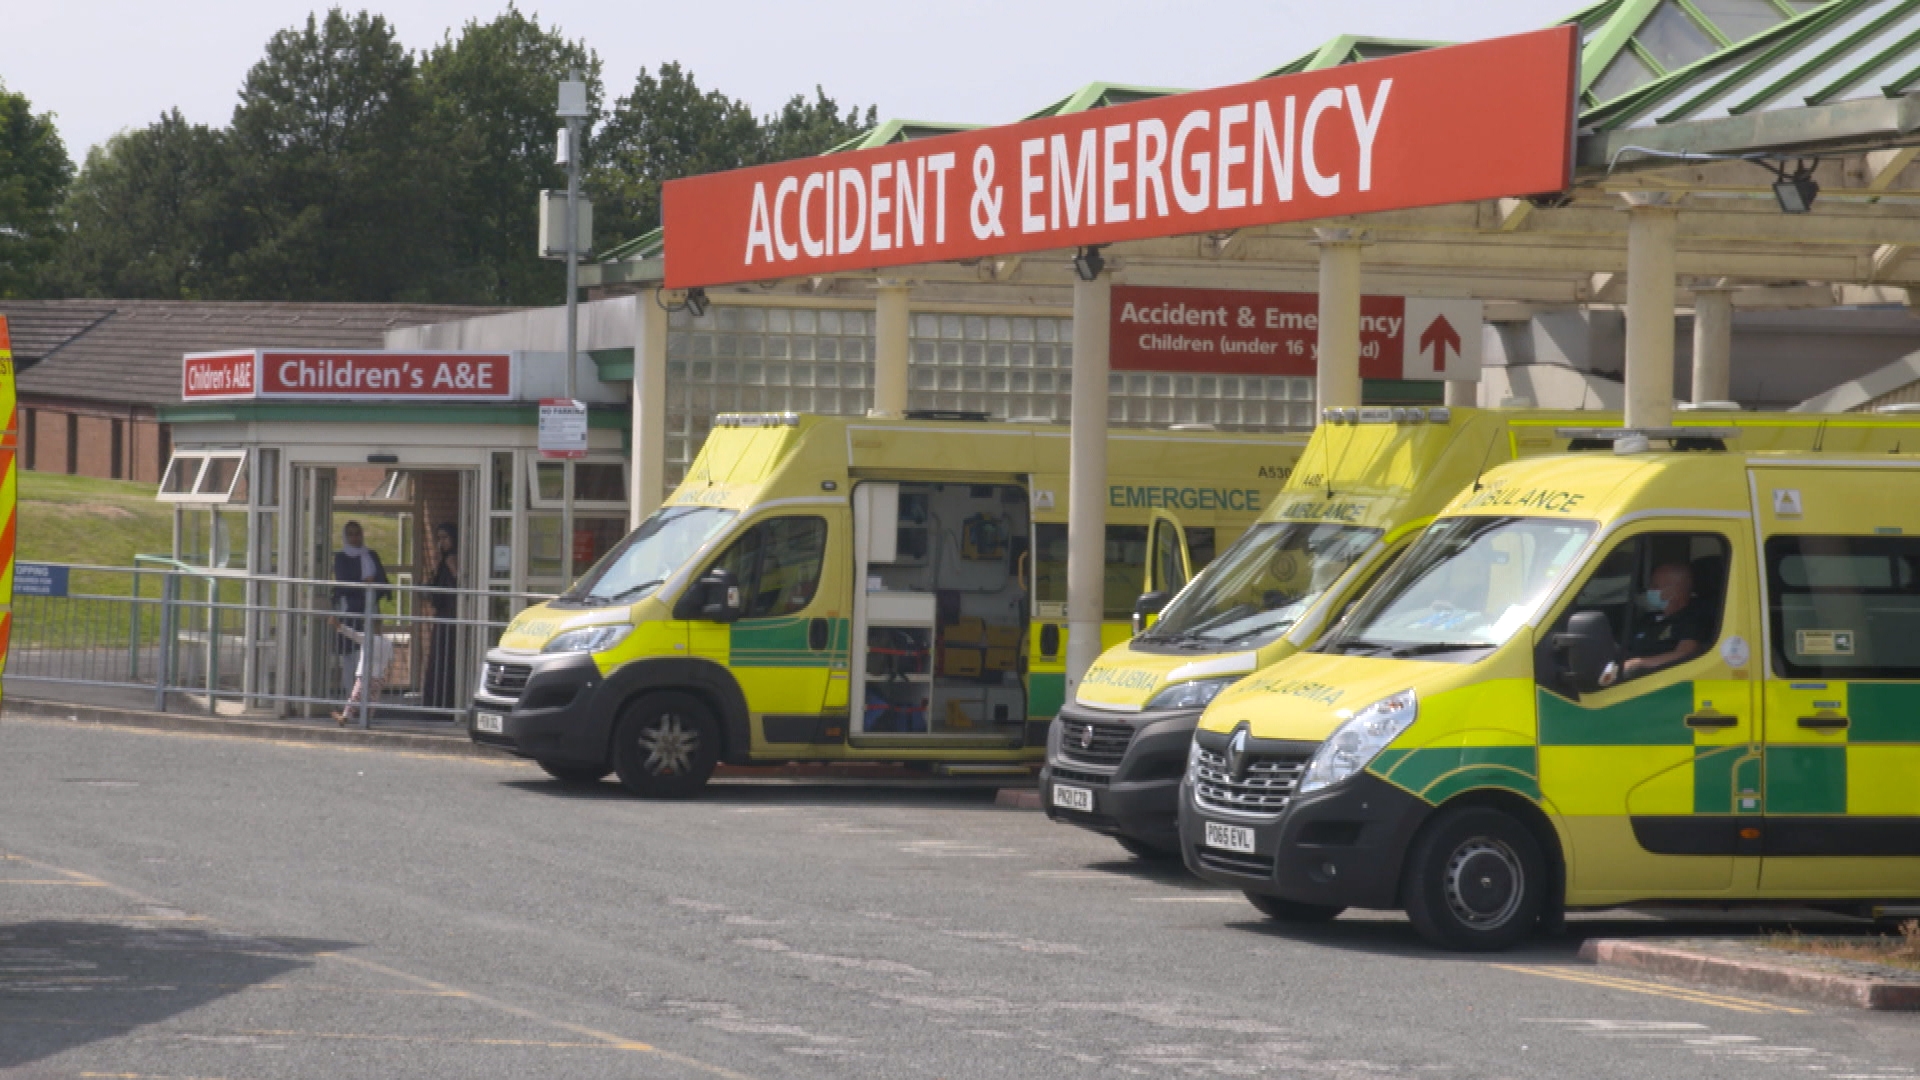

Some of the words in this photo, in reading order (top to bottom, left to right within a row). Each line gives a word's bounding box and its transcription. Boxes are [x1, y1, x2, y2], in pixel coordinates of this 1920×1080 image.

[745, 152, 956, 266] ACCIDENT
[971, 144, 1005, 241] &
[1021, 77, 1393, 234] EMERGENCY
[1120, 302, 1229, 328] Accident
[1236, 305, 1257, 329] &
[1265, 307, 1403, 339] Emency
[1138, 333, 1215, 353] Children
[1220, 335, 1278, 355] (under
[1285, 339, 1305, 355] 16
[1358, 340, 1381, 360] ld)
[188, 362, 232, 391] Children's
[233, 361, 252, 389] A&E
[278, 359, 424, 389] Children's
[432, 361, 494, 390] A&E
[1109, 485, 1261, 511] EMERGENCE
[1231, 827, 1251, 849] EVL
